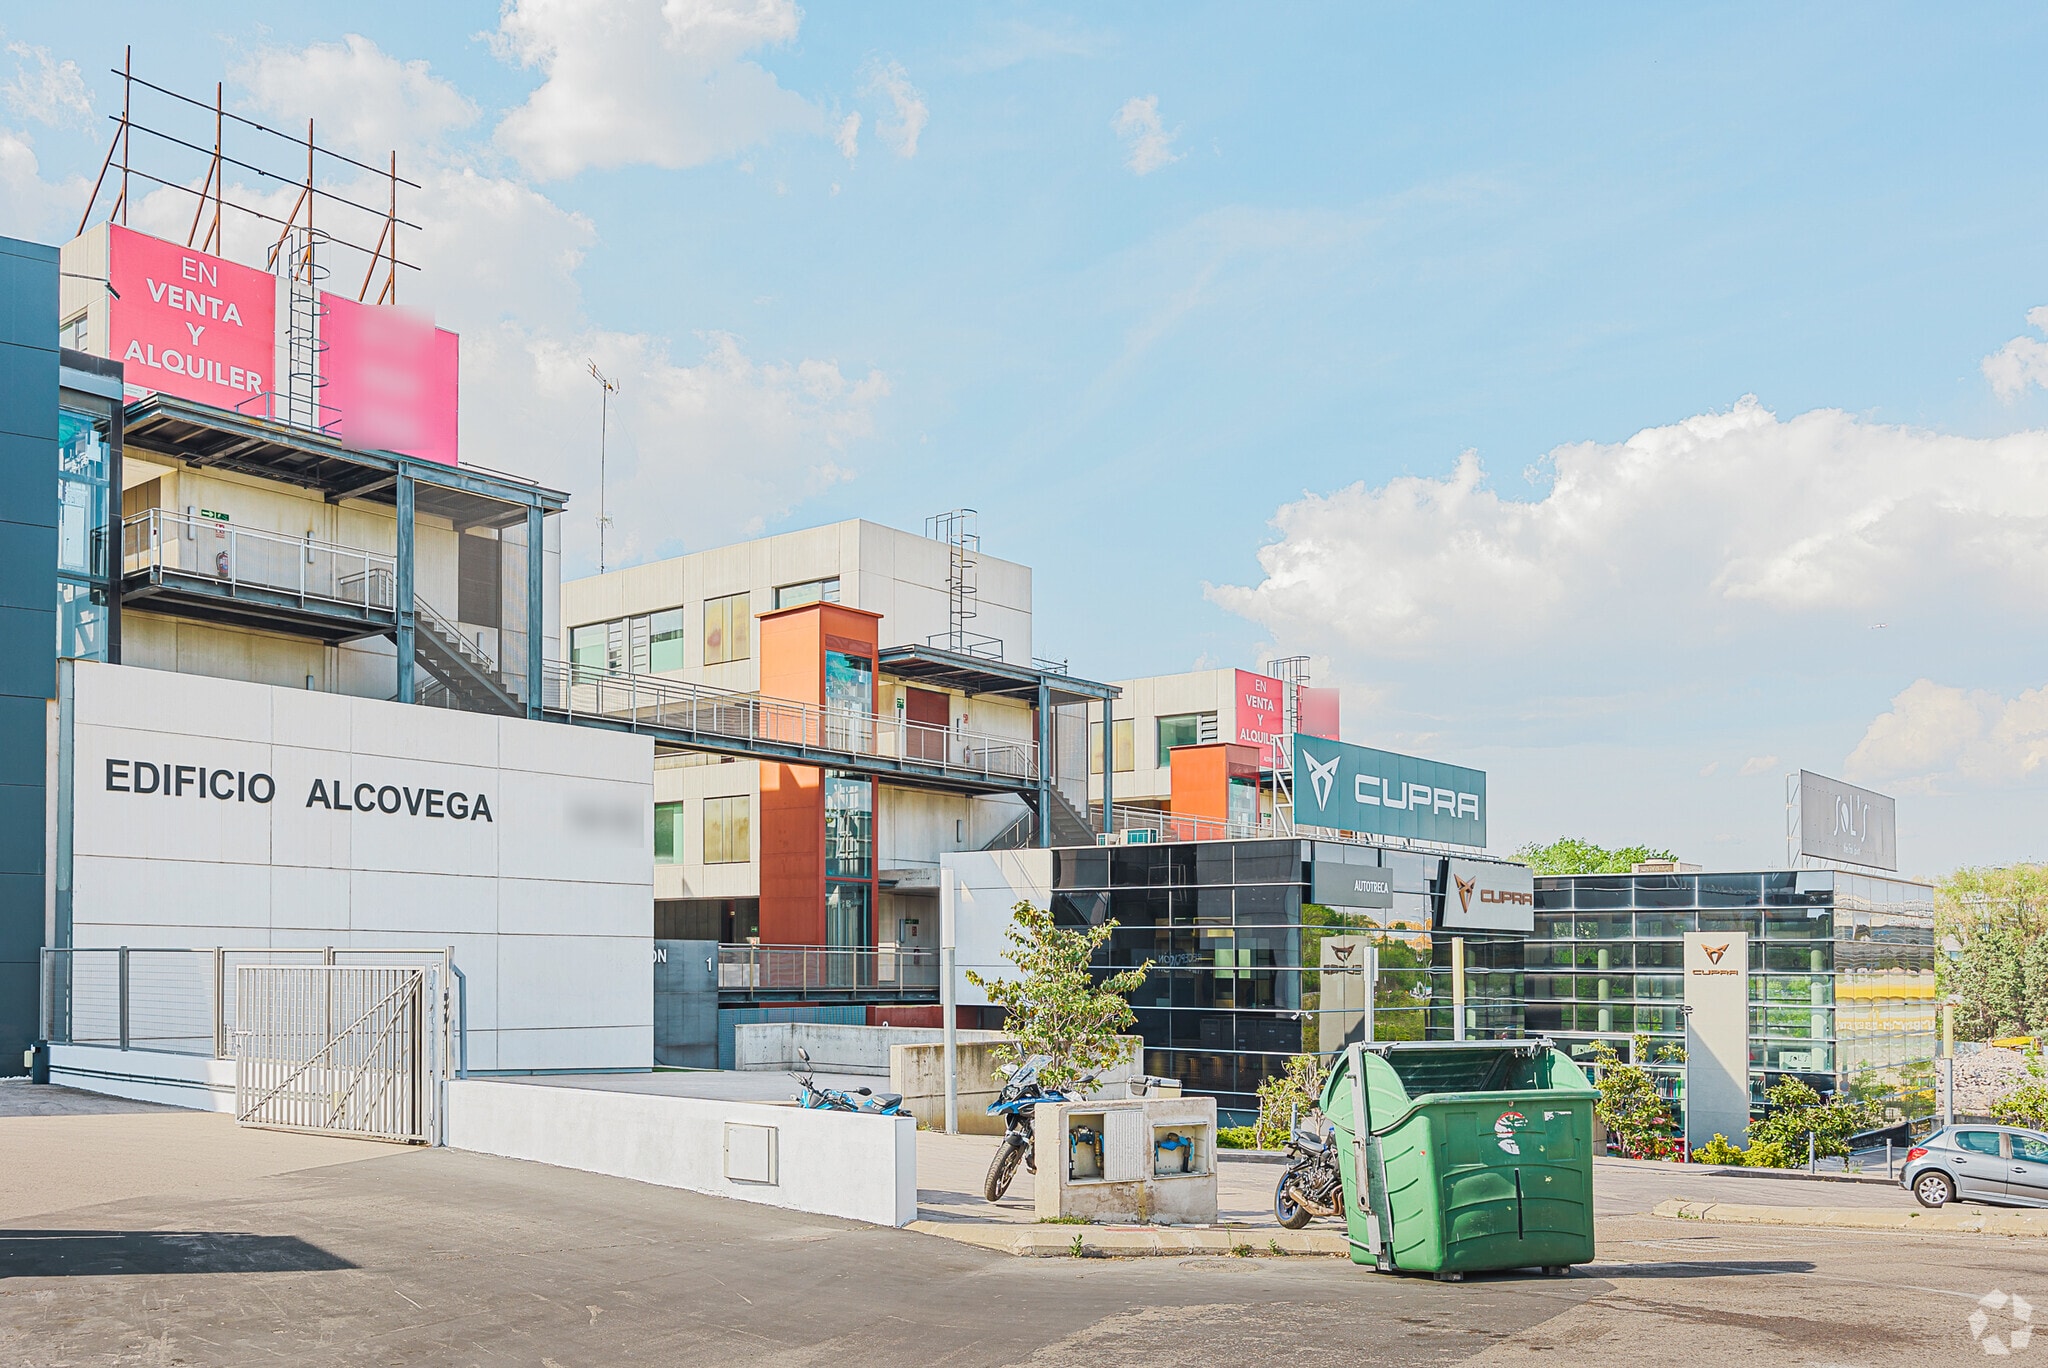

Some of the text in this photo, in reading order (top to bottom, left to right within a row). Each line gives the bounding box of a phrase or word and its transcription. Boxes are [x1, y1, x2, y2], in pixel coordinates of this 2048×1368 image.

[182, 256, 217, 288] EN
[146, 278, 243, 327] VENTA
[185, 321, 205, 346] Y
[123, 339, 262, 394] ALQUILER
[1255, 679, 1267, 693] EN
[1245, 694, 1274, 712] VENTA
[1257, 713, 1264, 726] Y
[1239, 727, 1274, 746] ALQUILE
[105, 758, 494, 822] EDIFICIO ALCOVEGA
[1355, 773, 1479, 821] CUPRA
[1354, 879, 1389, 894] AUTOTRECA
[1480, 889, 1533, 906] CUPRA
[705, 957, 712, 971] 1
